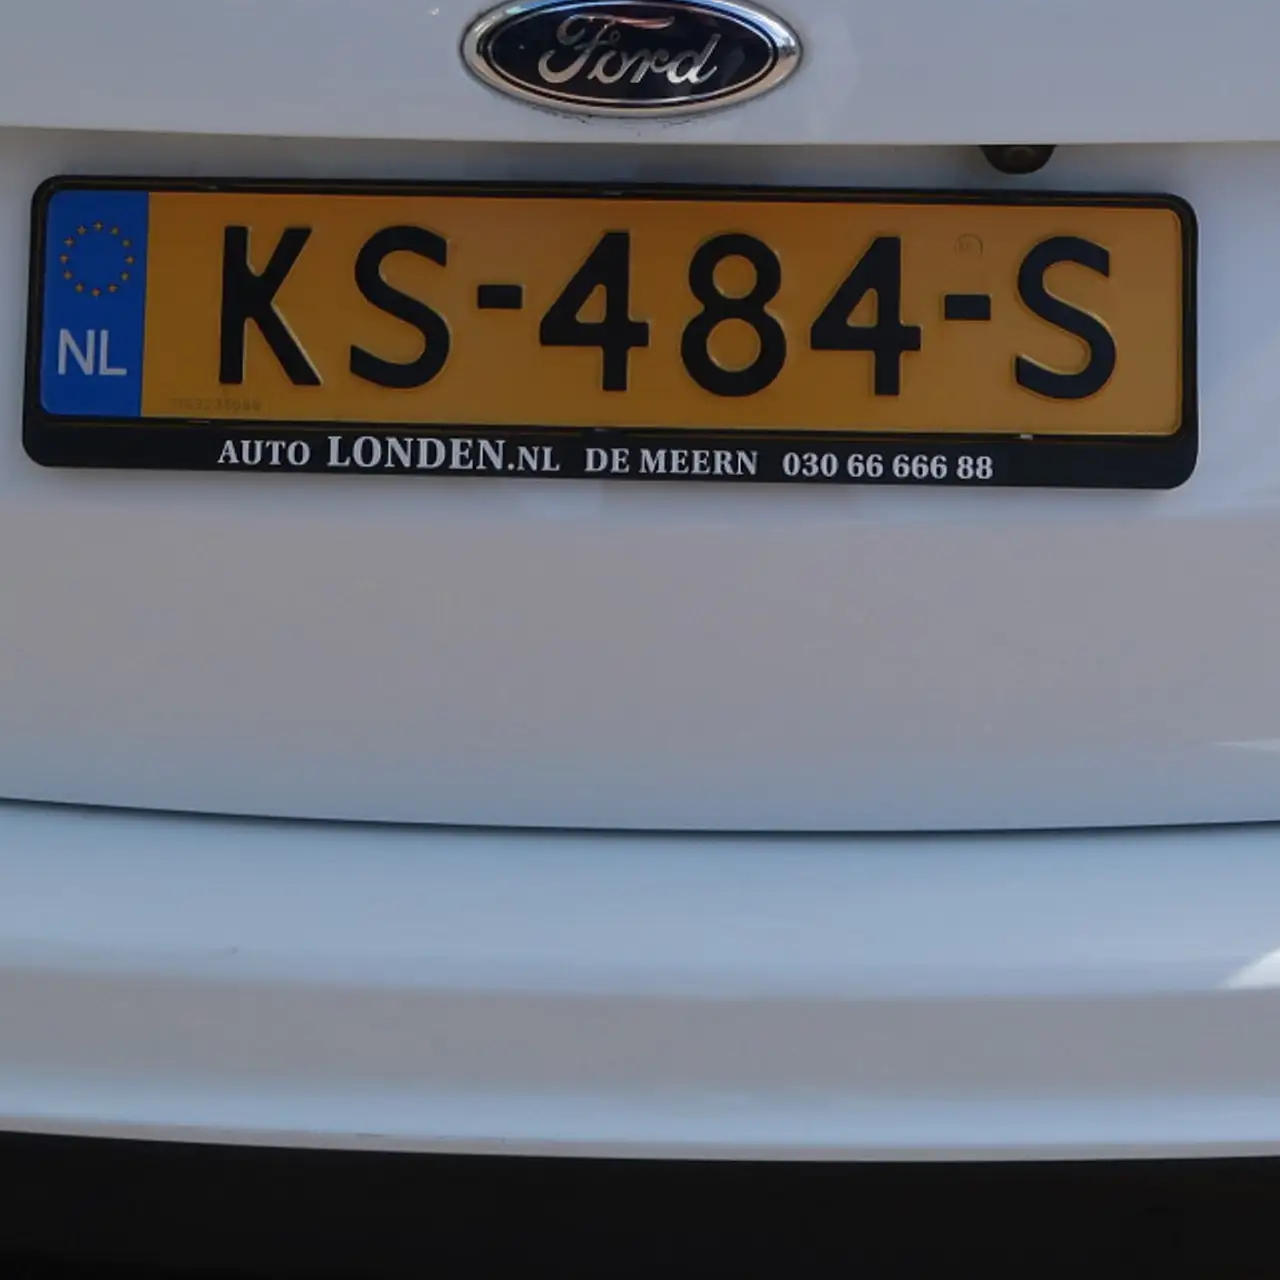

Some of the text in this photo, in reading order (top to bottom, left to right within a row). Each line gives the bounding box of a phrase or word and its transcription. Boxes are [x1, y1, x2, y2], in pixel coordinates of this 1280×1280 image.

[538, 13, 720, 84] Ford
[218, 224, 1117, 402] KS-484-S
[58, 328, 128, 376] NL
[218, 436, 994, 480] AUTO LONDEN.NL DE MEERN 030 66 666 88
